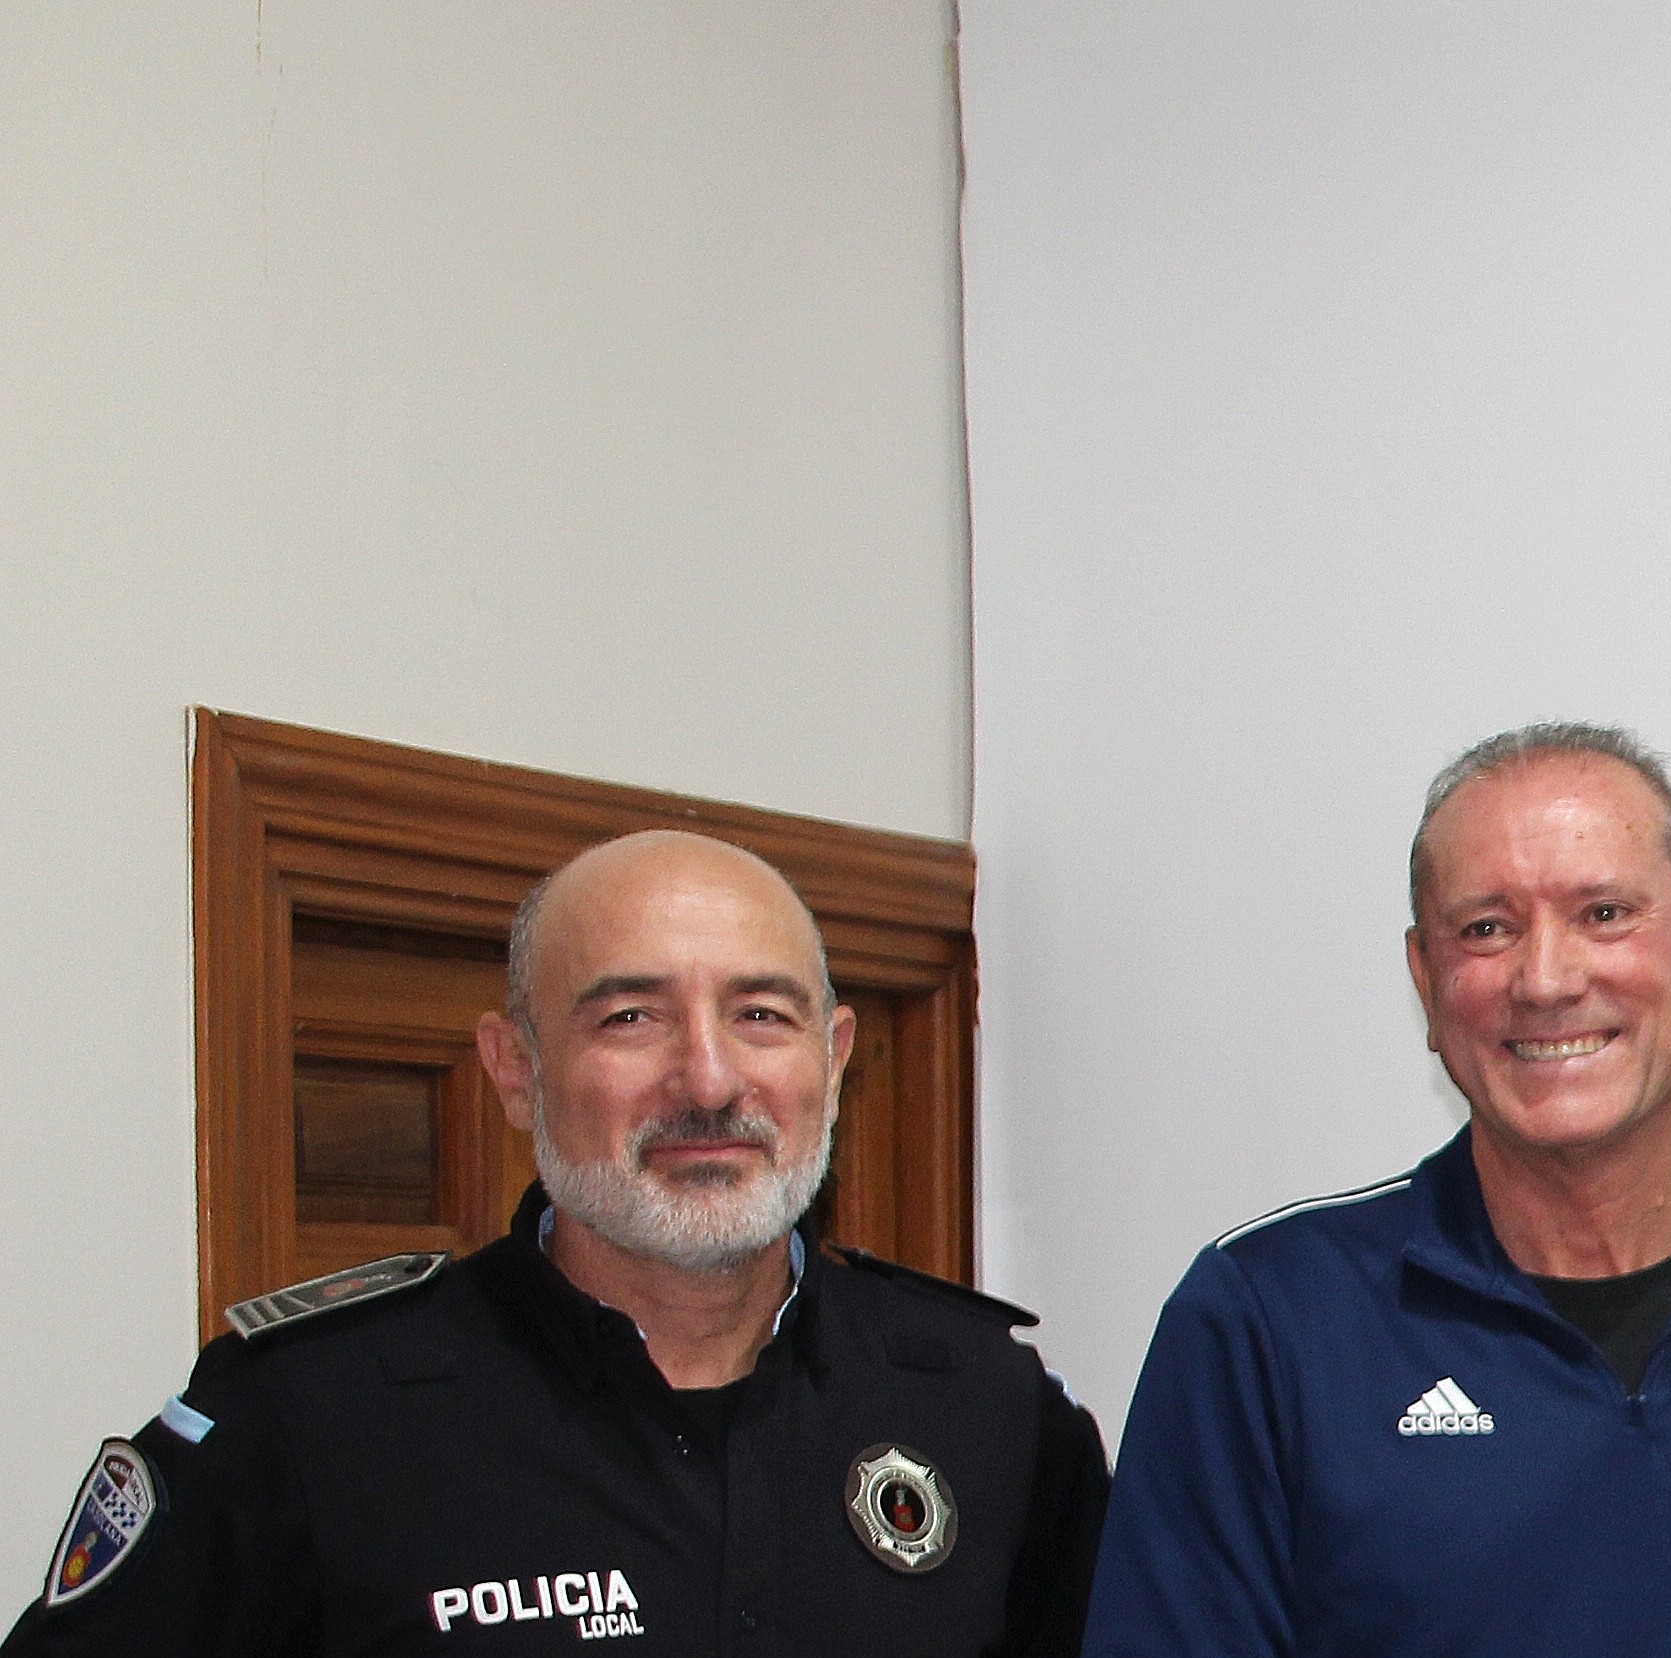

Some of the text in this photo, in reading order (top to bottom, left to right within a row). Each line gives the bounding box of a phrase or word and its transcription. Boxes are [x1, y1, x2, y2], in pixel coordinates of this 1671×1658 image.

[1398, 1411, 1495, 1436] adidas
[432, 1569, 639, 1632] POLICIA
[579, 1612, 645, 1640] LOCAL
